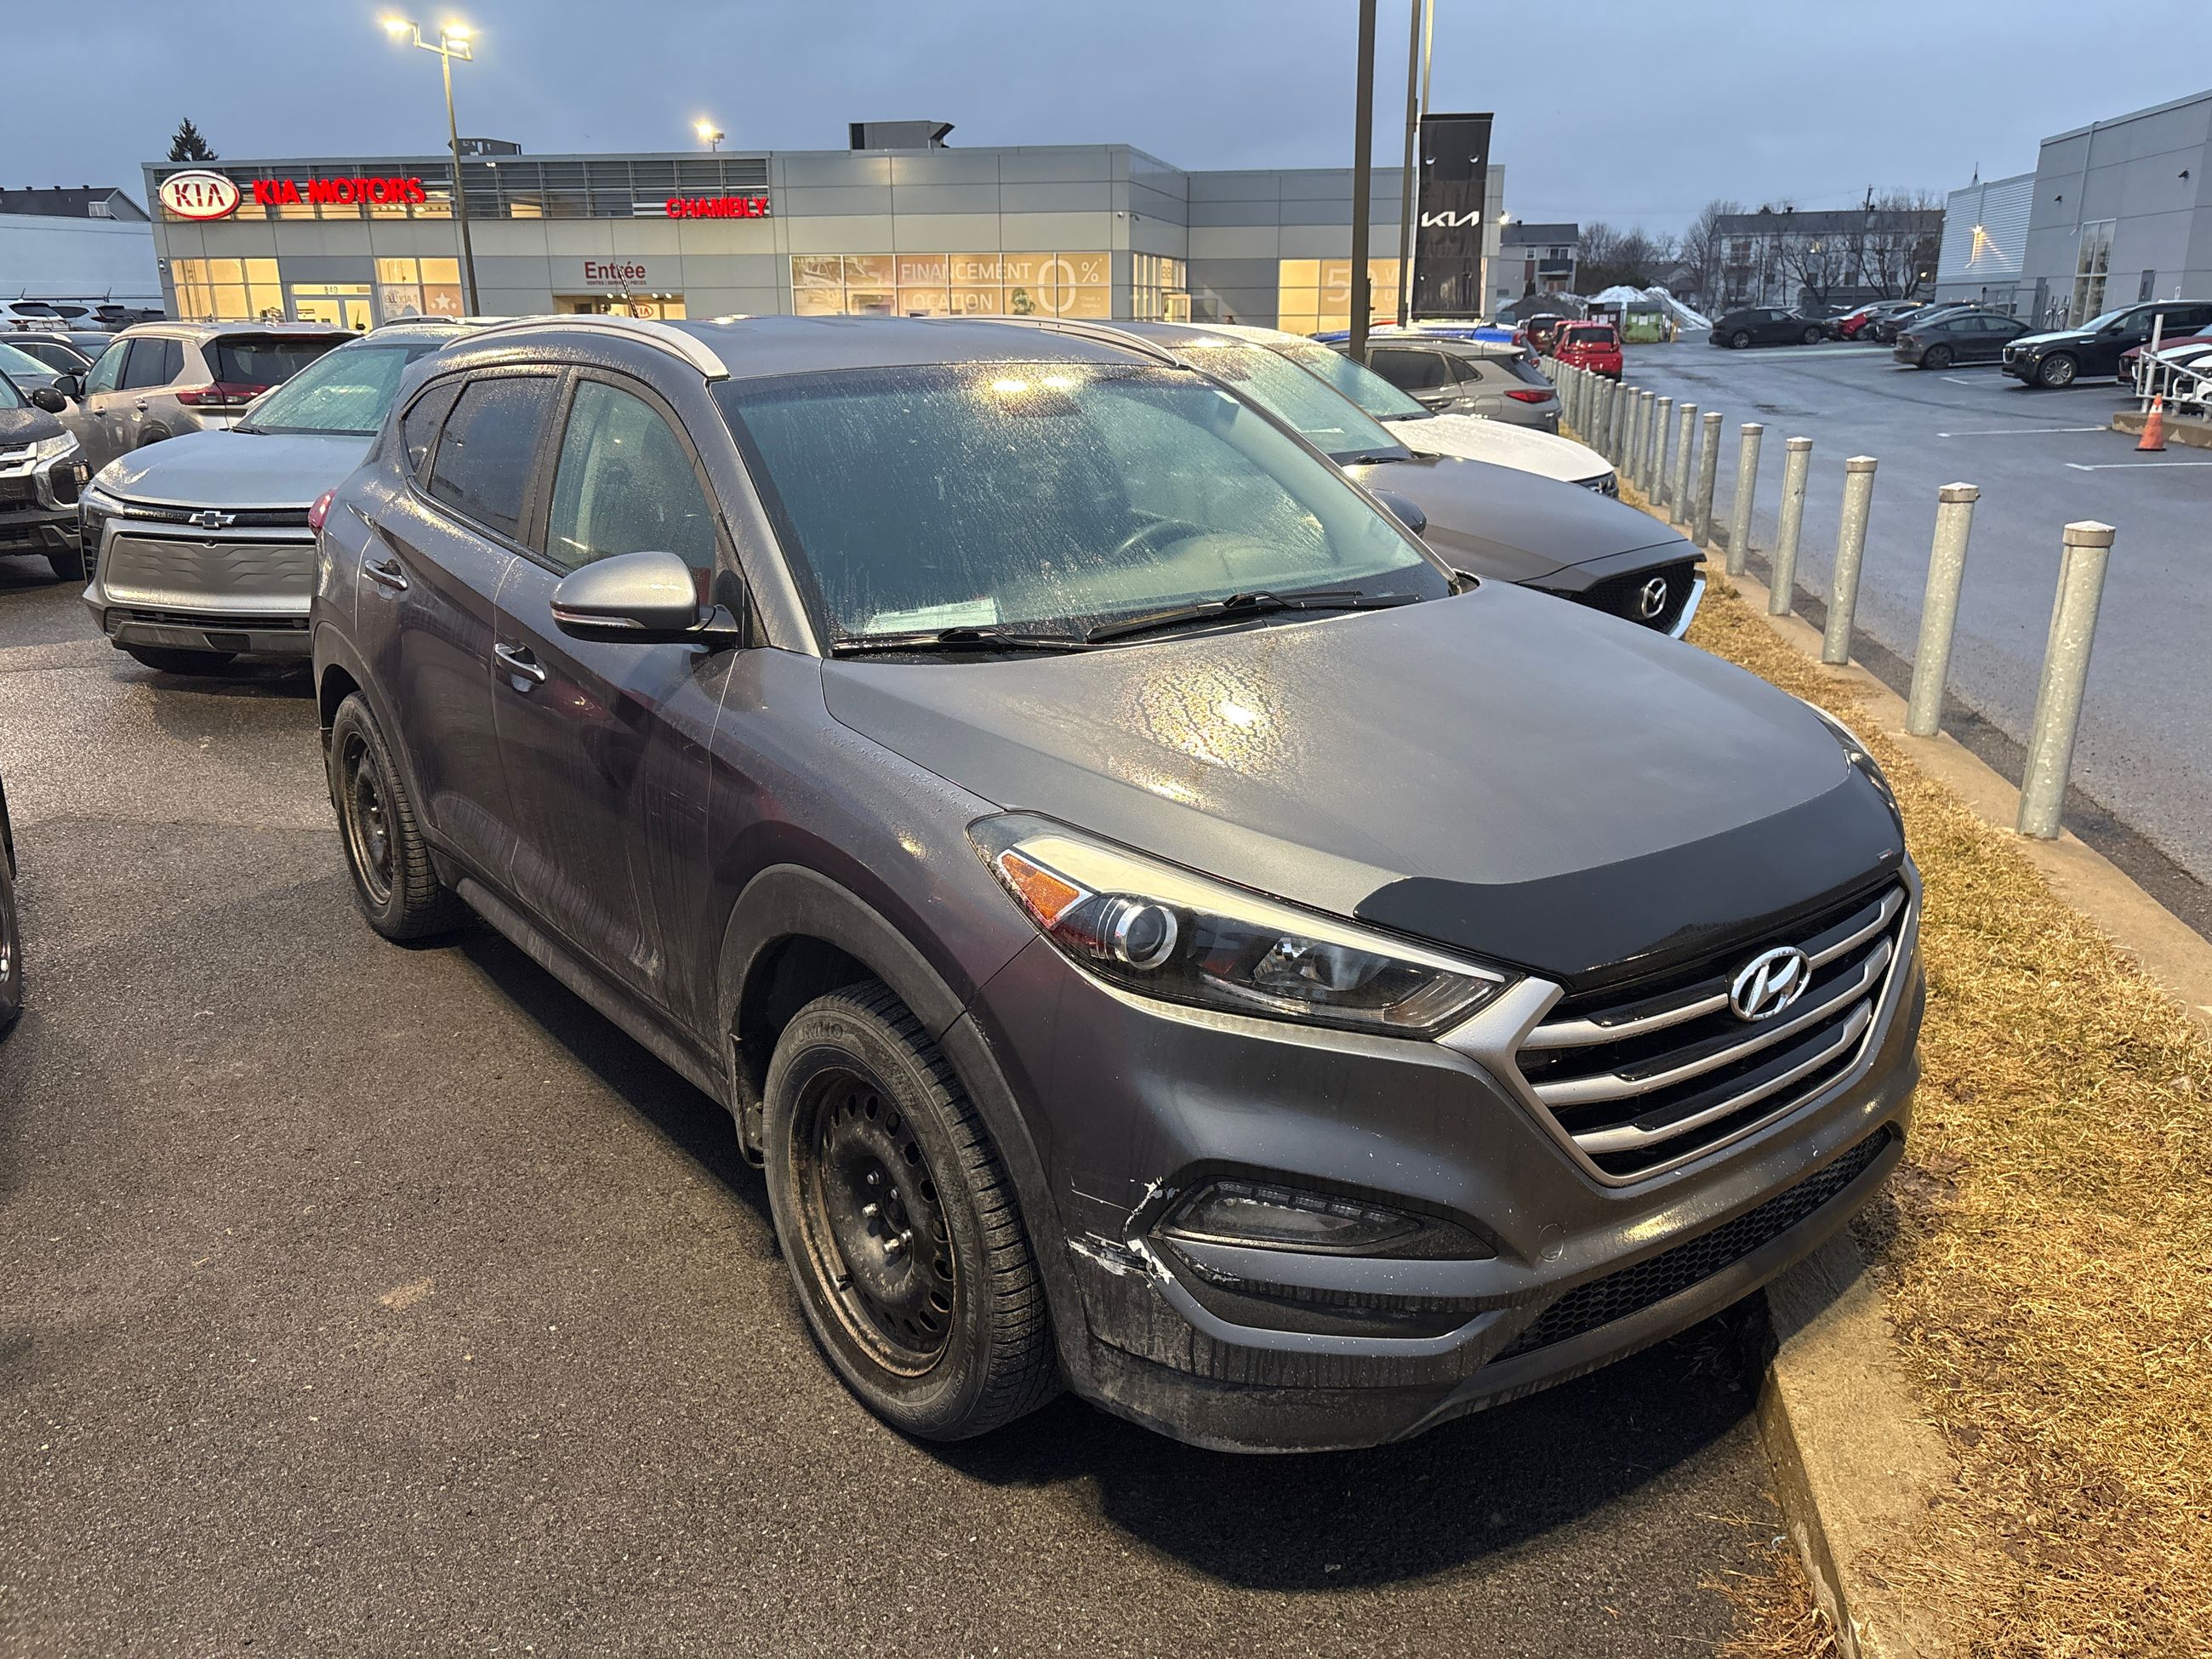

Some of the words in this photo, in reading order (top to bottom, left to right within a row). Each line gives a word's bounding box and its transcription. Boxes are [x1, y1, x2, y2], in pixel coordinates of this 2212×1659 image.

[252, 178, 304, 206] KIA
[308, 176, 427, 205] MOTORS
[665, 197, 768, 218] CHAMBLY
[584, 260, 647, 279] Entrée
[900, 262, 1033, 281] FINANCEMENT
[903, 293, 994, 311] LOCATION
